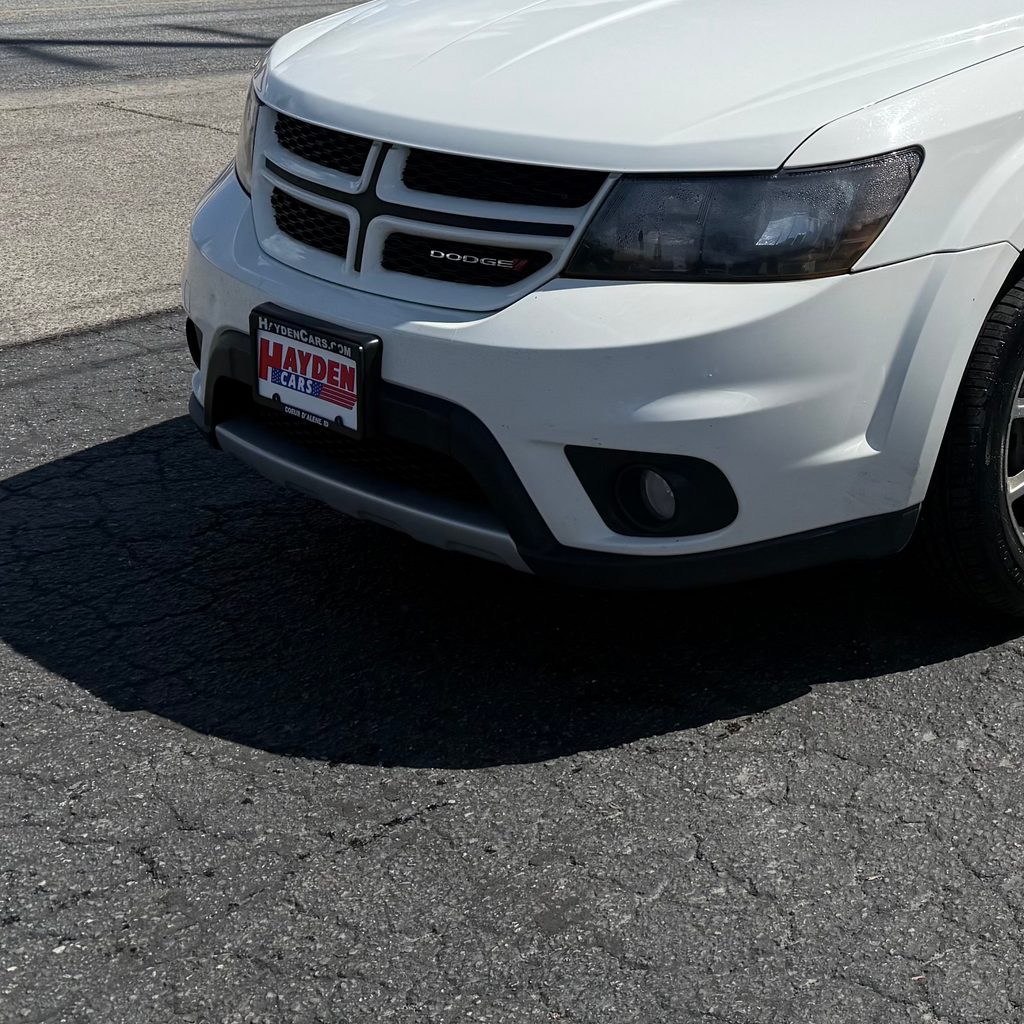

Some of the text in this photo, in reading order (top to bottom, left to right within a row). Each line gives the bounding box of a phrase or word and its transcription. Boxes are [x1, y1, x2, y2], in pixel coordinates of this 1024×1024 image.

[429, 250, 513, 268] DODGE
[258, 338, 355, 392] HAYDEN
[280, 371, 313, 394] CARS
